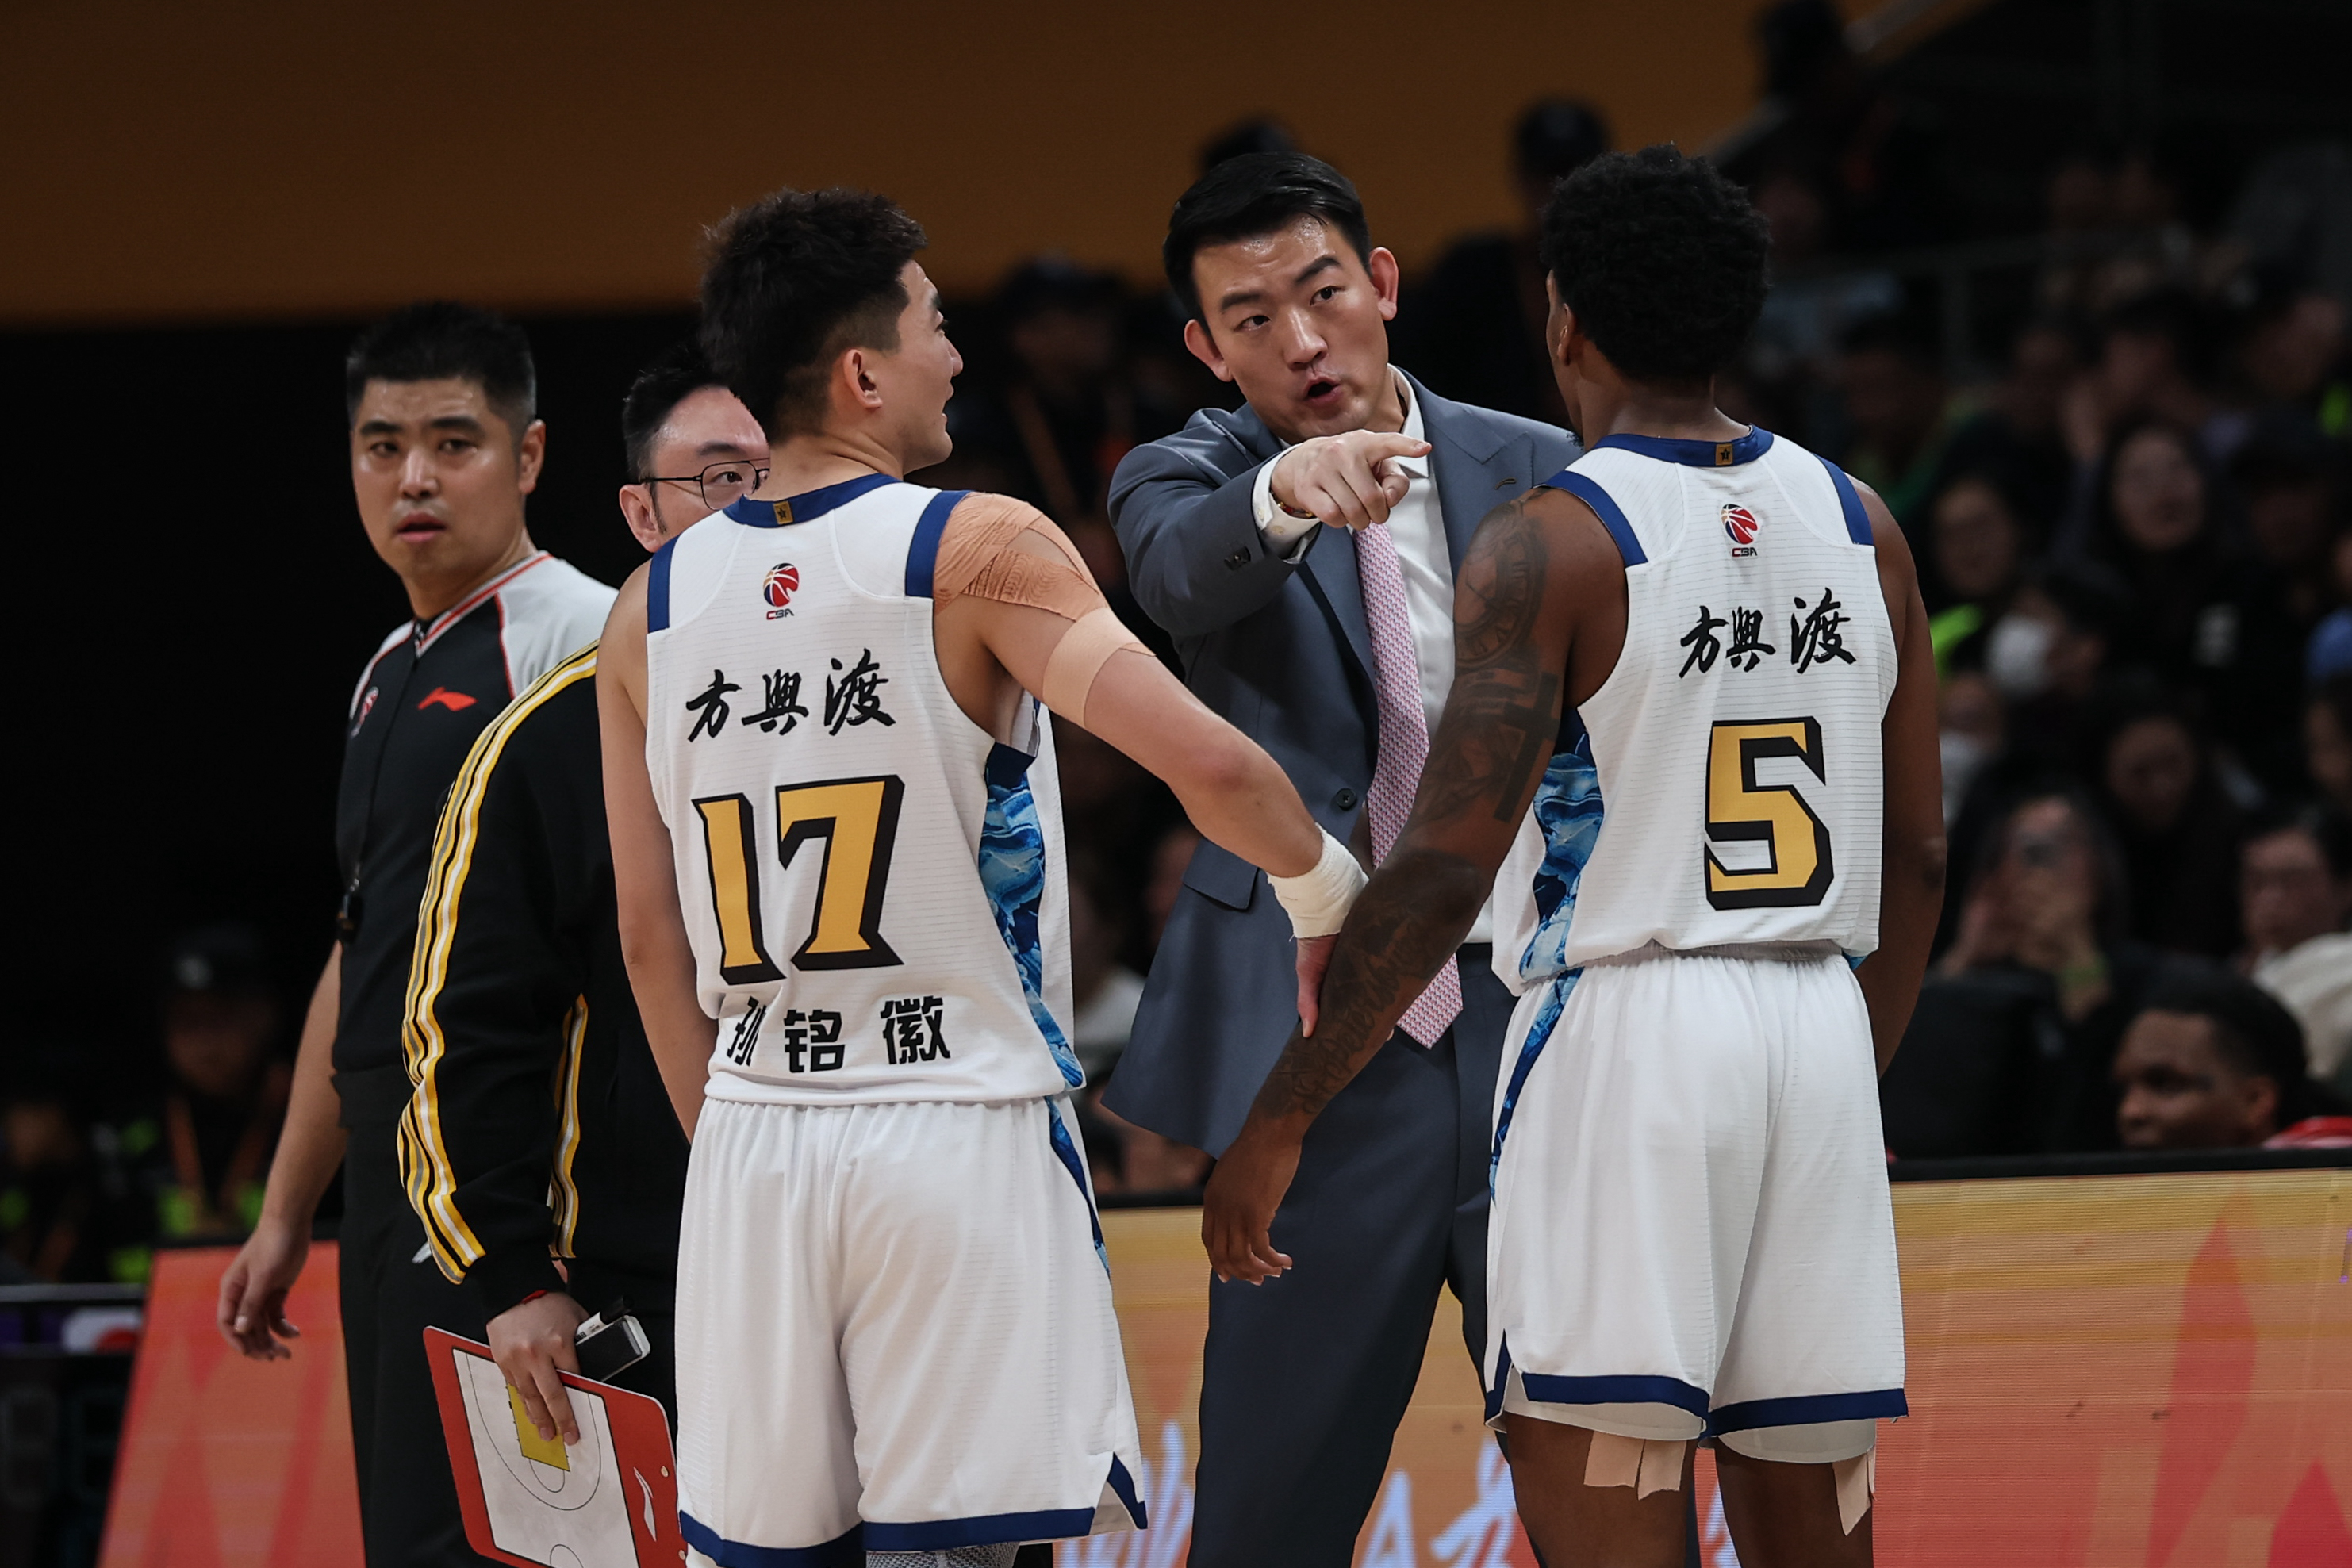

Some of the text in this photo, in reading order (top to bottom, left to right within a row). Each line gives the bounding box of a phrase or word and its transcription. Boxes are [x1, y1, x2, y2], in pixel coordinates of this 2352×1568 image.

[1732, 547, 1758, 558] CBA
[766, 608, 795, 621] CBA
[1704, 716, 1835, 911] 5
[691, 774, 906, 986] 17
